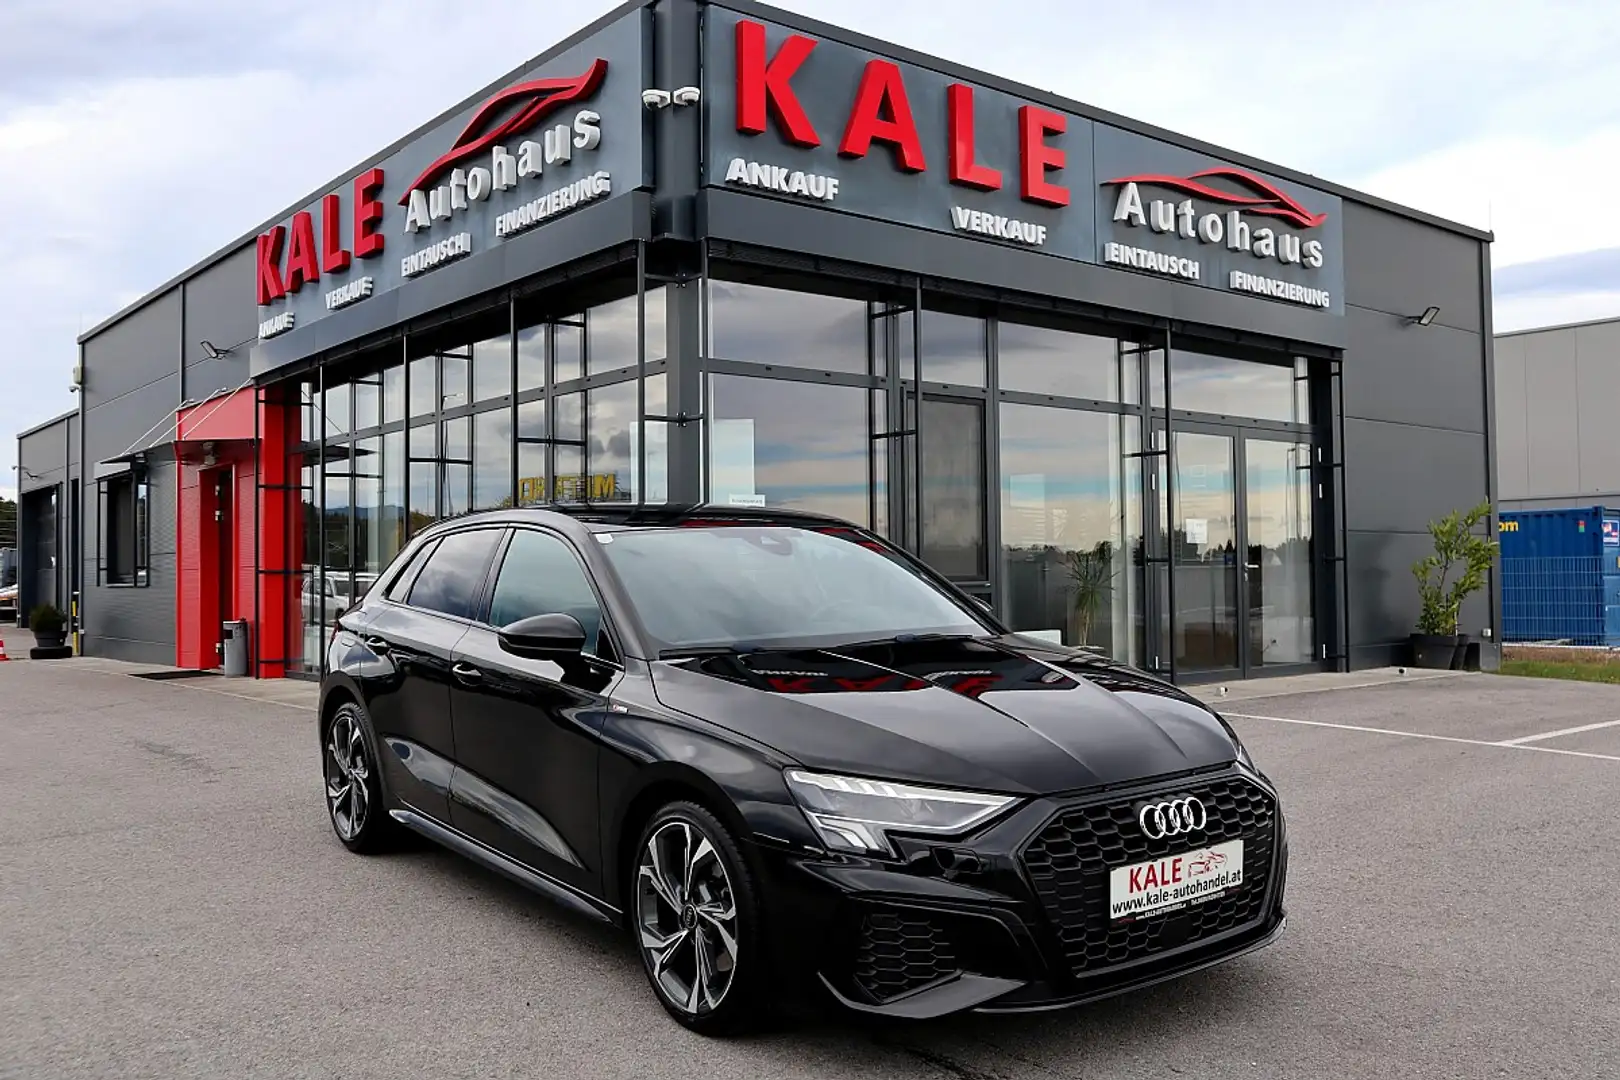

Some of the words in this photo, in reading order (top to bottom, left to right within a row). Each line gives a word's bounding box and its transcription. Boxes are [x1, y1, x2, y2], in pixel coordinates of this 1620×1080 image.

[736, 20, 1070, 208] KALE
[404, 110, 601, 233] Autohaus
[725, 157, 839, 201] ANKAUF
[495, 171, 611, 237] FINANZIERUNG
[950, 206, 1047, 245] VERKAUF
[1113, 182, 1323, 269] Autohaus
[256, 168, 385, 306] KALE
[401, 232, 472, 277] EINTAUSCH
[1104, 242, 1200, 280] EINTAUSCH
[325, 276, 374, 310] VERKAUF
[1229, 270, 1330, 308] FINANZIERUNG
[258, 311, 295, 339] ANKAUF
[1112, 869, 1242, 915] www.kale-autohandel.at
[1129, 857, 1183, 893] KALE
